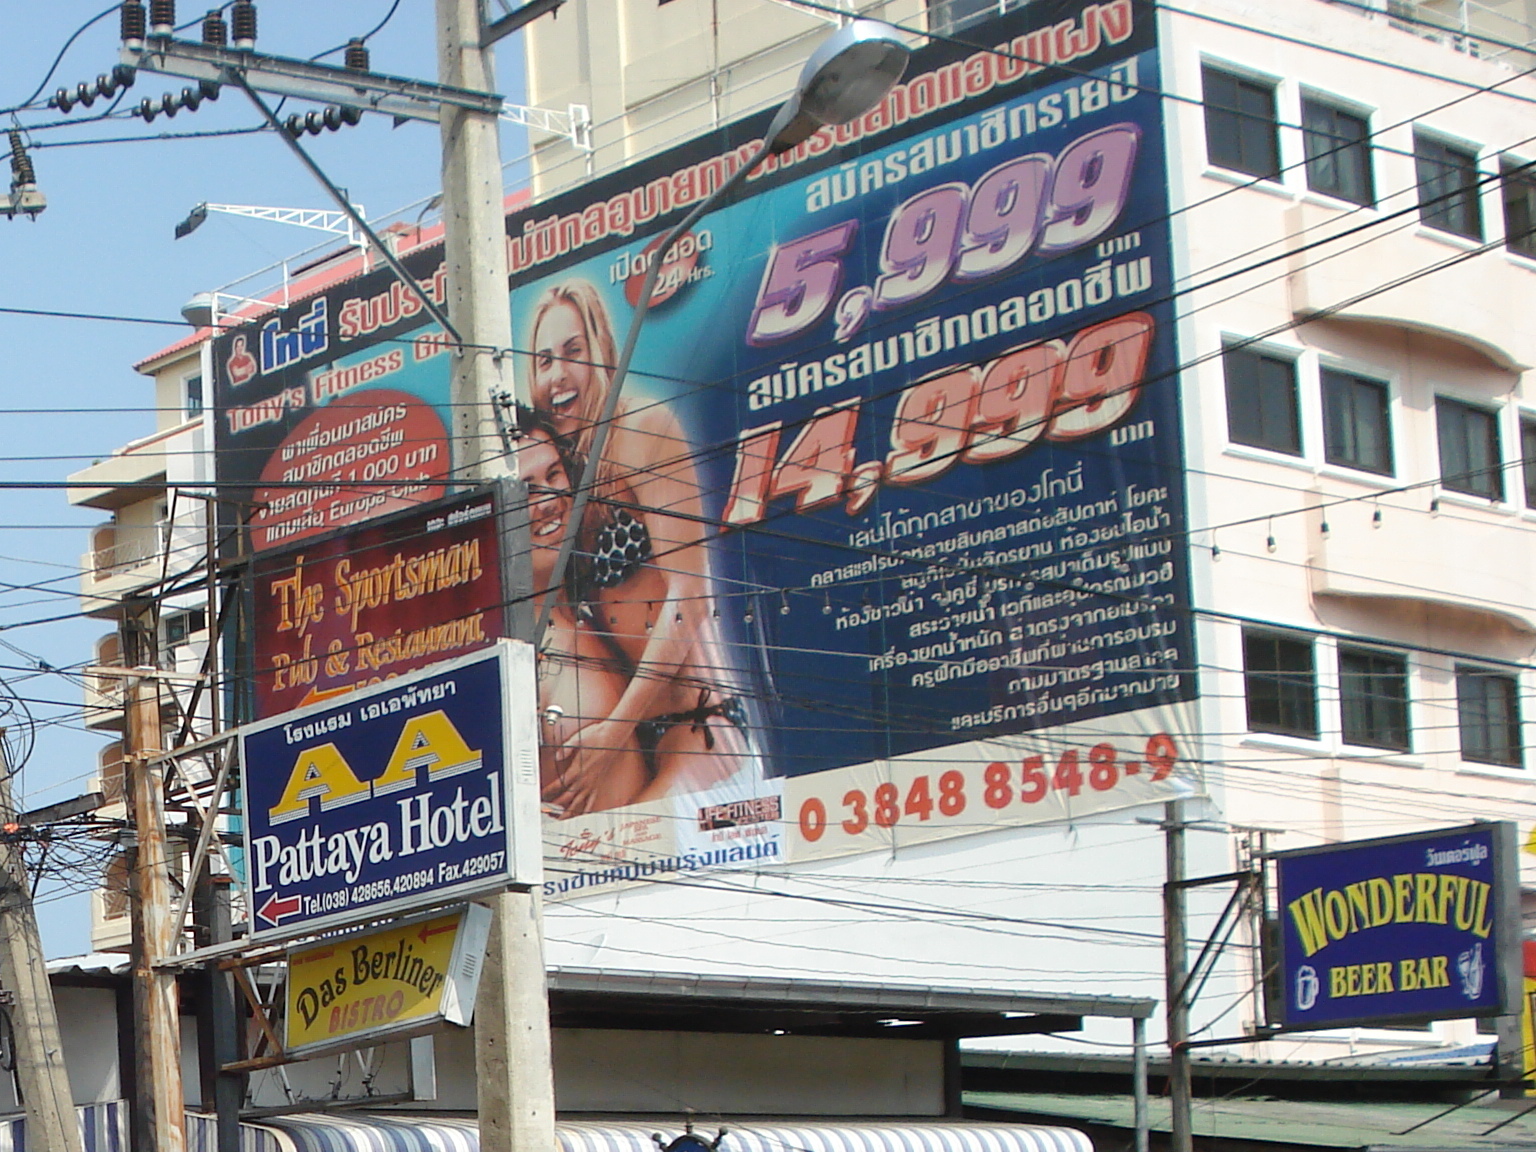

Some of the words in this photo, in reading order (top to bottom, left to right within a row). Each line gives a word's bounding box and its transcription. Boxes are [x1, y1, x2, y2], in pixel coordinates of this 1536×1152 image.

[805, 54, 1140, 214] สมัครสมาชิกรายปี
[745, 122, 1143, 348] 5,999
[1096, 230, 1142, 260] บาท
[260, 296, 329, 375] โทนี่
[748, 256, 1154, 412] สมัครสมาชิกตลอดชีพ
[226, 386, 306, 435] Tony's
[313, 348, 402, 402] Fitness
[719, 309, 1155, 534] 14,999
[404, 443, 438, 468] บาท
[1109, 419, 1155, 447] บาท
[329, 491, 387, 523] Europa
[849, 460, 1084, 548] เล่นได้ทุกสาขาของโทนี่
[1126, 483, 1168, 508] โยคะ
[271, 554, 325, 638] The
[334, 538, 483, 633] Sportsman
[271, 633, 318, 692] Pub
[324, 638, 350, 678] &
[283, 711, 352, 745] โรงแรม
[359, 679, 456, 723] เอเอพัทยา
[798, 797, 827, 843] 0
[841, 769, 968, 836] 3848
[983, 732, 1179, 810] 8548-9
[251, 820, 393, 894] Pattaya
[396, 770, 505, 858] Hotel
[303, 892, 350, 916] Tel.(038)
[351, 871, 434, 905] 428656,420894
[437, 850, 506, 884] Fax.429057
[1288, 872, 1493, 958] WONDERFUL
[295, 966, 348, 1032] Das
[350, 937, 443, 1000] Berliner
[328, 989, 405, 1034] BISTRO
[1329, 961, 1395, 999] BEER
[1398, 955, 1451, 992] BAR
